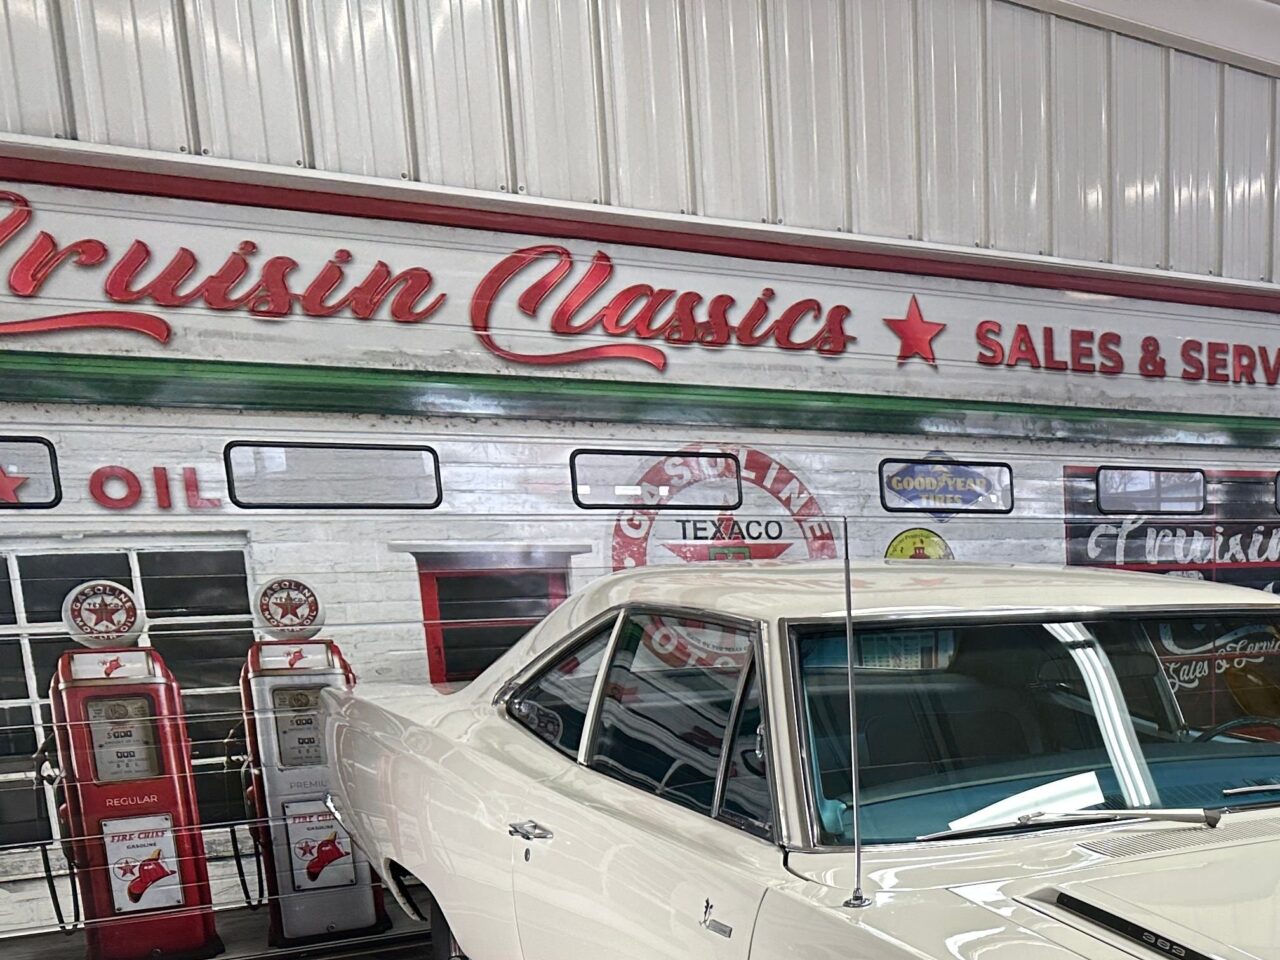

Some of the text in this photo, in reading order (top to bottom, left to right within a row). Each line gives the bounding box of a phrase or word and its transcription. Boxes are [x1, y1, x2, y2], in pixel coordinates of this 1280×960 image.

[471, 245, 857, 371] Classics
[975, 321, 1122, 375] SALES
[1139, 335, 1168, 379] &
[88, 464, 221, 511] OIL
[619, 448, 830, 540] GASOLINE
[920, 493, 962, 506] TIRES
[676, 519, 783, 541] TEXACO
[73, 586, 134, 609] GASOLINE
[261, 581, 315, 604] GASOLINE
[120, 616, 135, 632] OIL
[303, 610, 317, 625] OIL
[106, 794, 158, 807] REGULAR
[126, 842, 157, 850] GASOLINE
